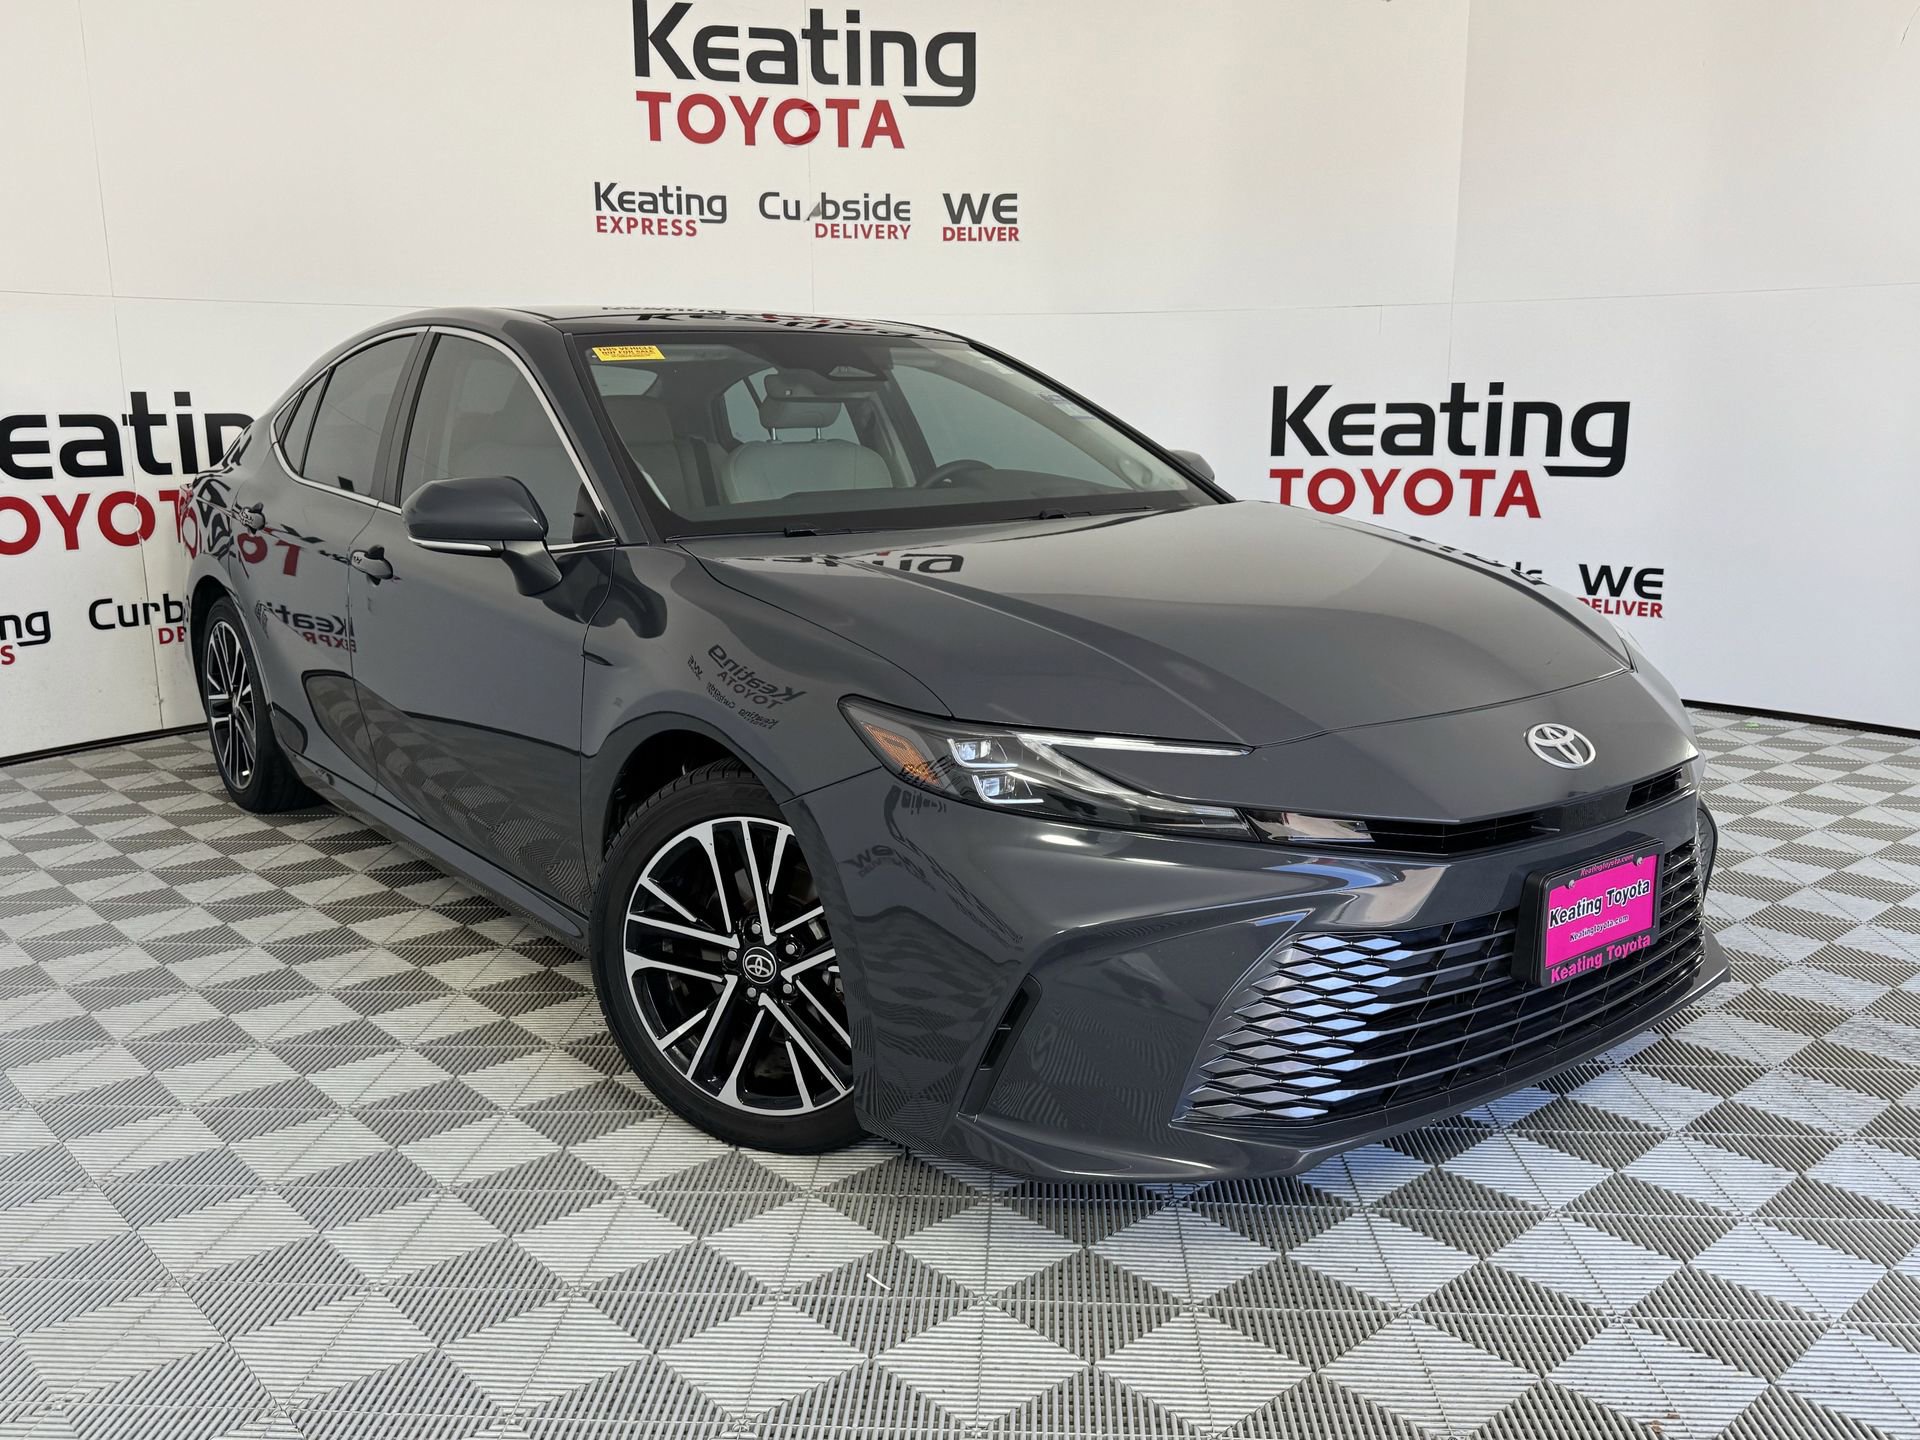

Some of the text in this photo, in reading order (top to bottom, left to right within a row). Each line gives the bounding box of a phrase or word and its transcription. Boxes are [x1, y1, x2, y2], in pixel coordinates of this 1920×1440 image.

[632, 0, 976, 107] Keating
[636, 91, 905, 149] TOYOTA
[594, 182, 727, 224] Keating
[759, 192, 911, 222] Cubside
[942, 193, 1017, 225] WE
[596, 215, 697, 237] EXPRESS
[815, 223, 911, 240] DELIVERY
[943, 227, 1020, 242] DELIVER
[1270, 381, 1631, 478] Keating
[1269, 468, 1541, 518] TOYOTA
[1578, 564, 1664, 600] WE
[1549, 880, 1650, 927] Keating Toyota
[1551, 934, 1651, 984] Keating Toyota
